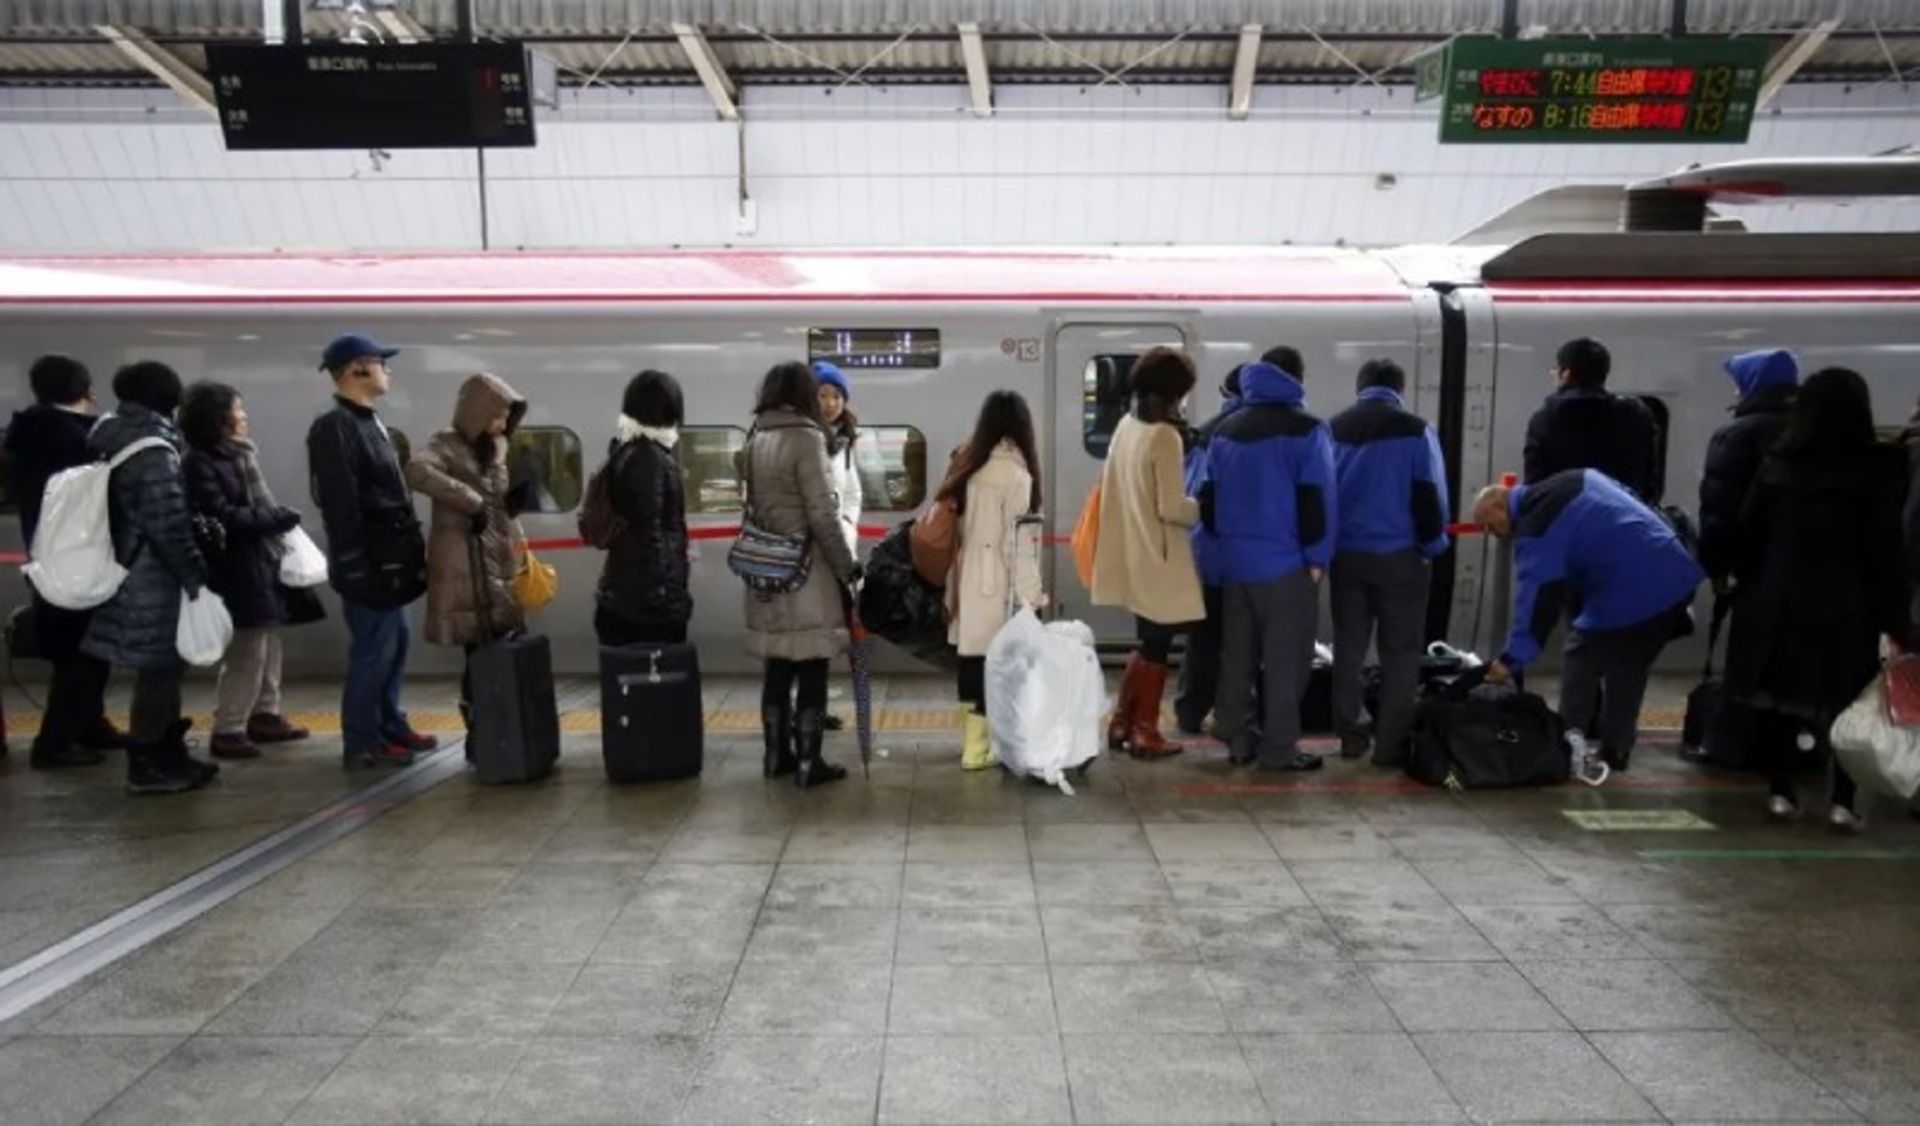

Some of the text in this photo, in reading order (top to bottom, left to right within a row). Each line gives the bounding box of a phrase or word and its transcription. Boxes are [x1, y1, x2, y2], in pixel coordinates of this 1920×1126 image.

[1704, 67, 1731, 100] 13
[1474, 104, 1534, 128] なすの
